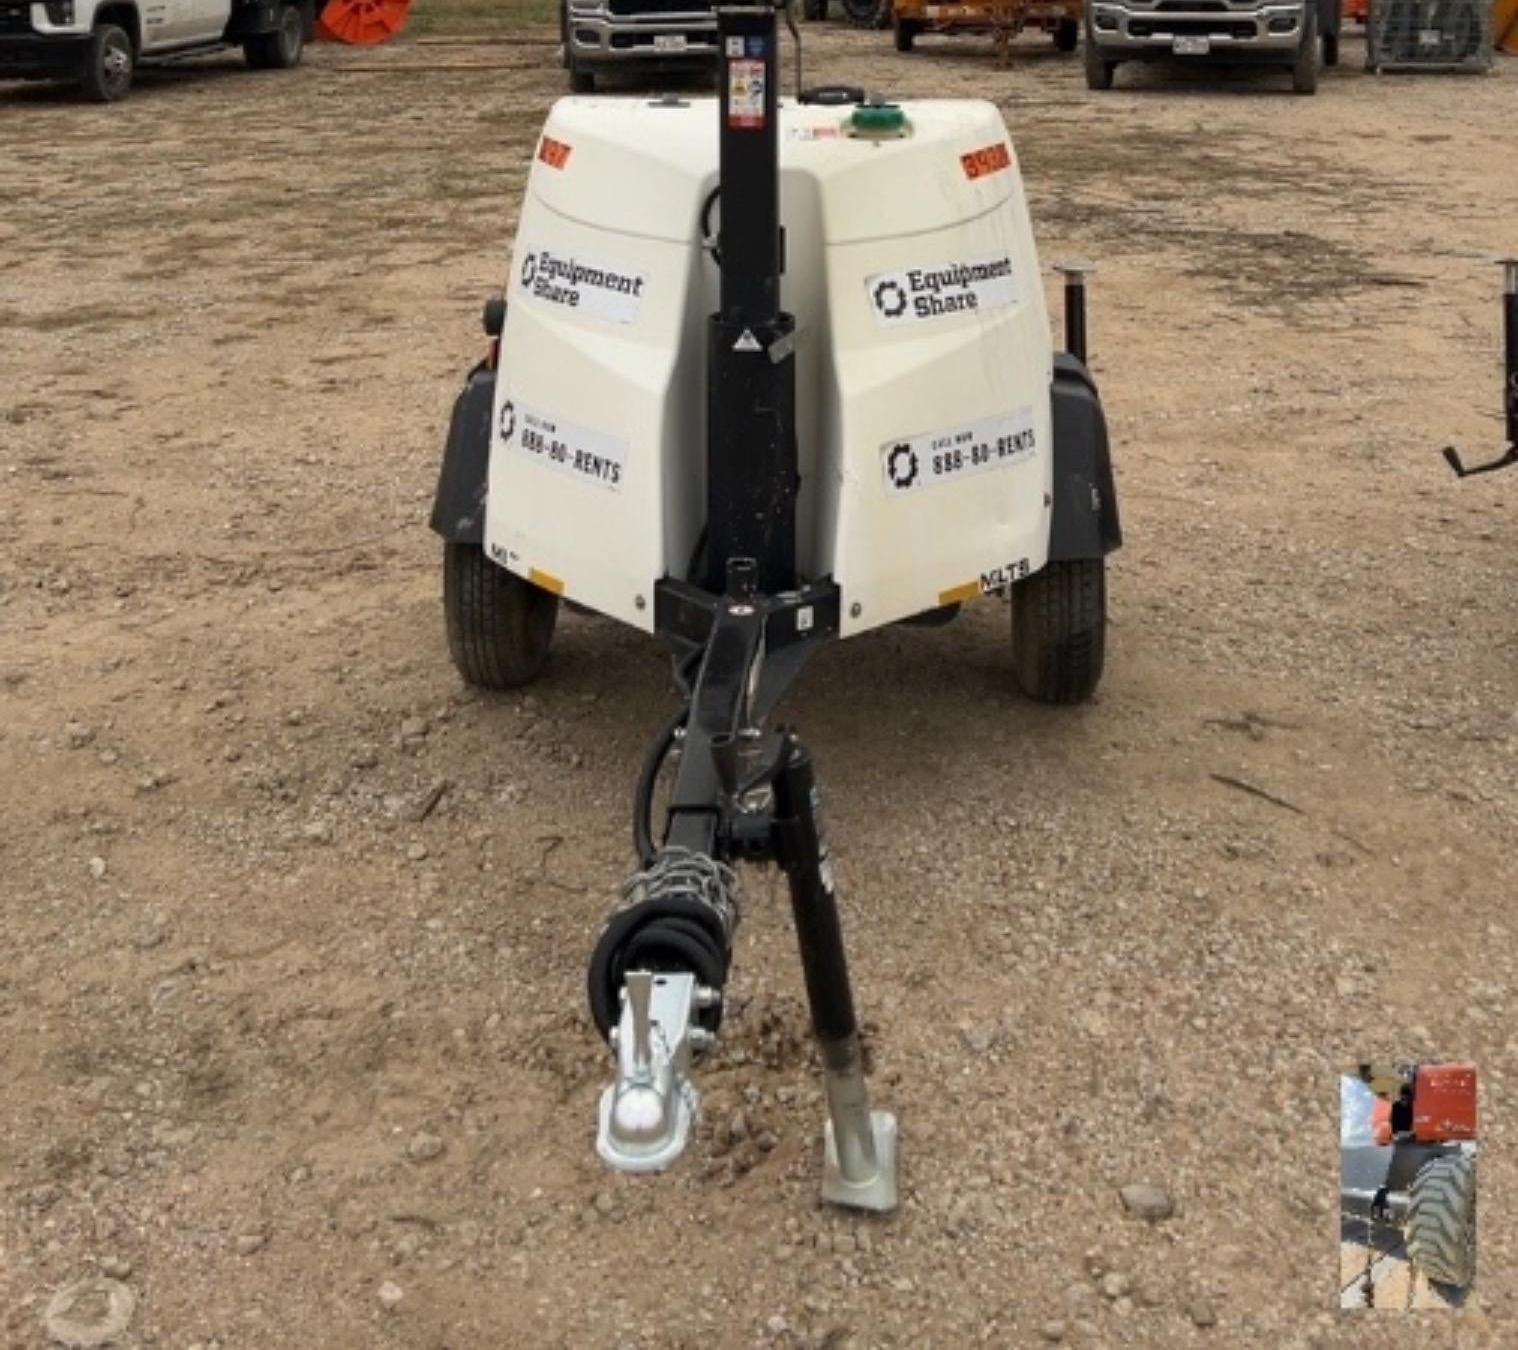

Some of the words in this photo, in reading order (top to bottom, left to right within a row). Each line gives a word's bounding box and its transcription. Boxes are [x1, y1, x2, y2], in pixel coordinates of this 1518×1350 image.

[539, 252, 643, 296] Equipment
[907, 258, 1012, 293] Equipment
[533, 276, 580, 307] Share
[913, 292, 978, 318] Share
